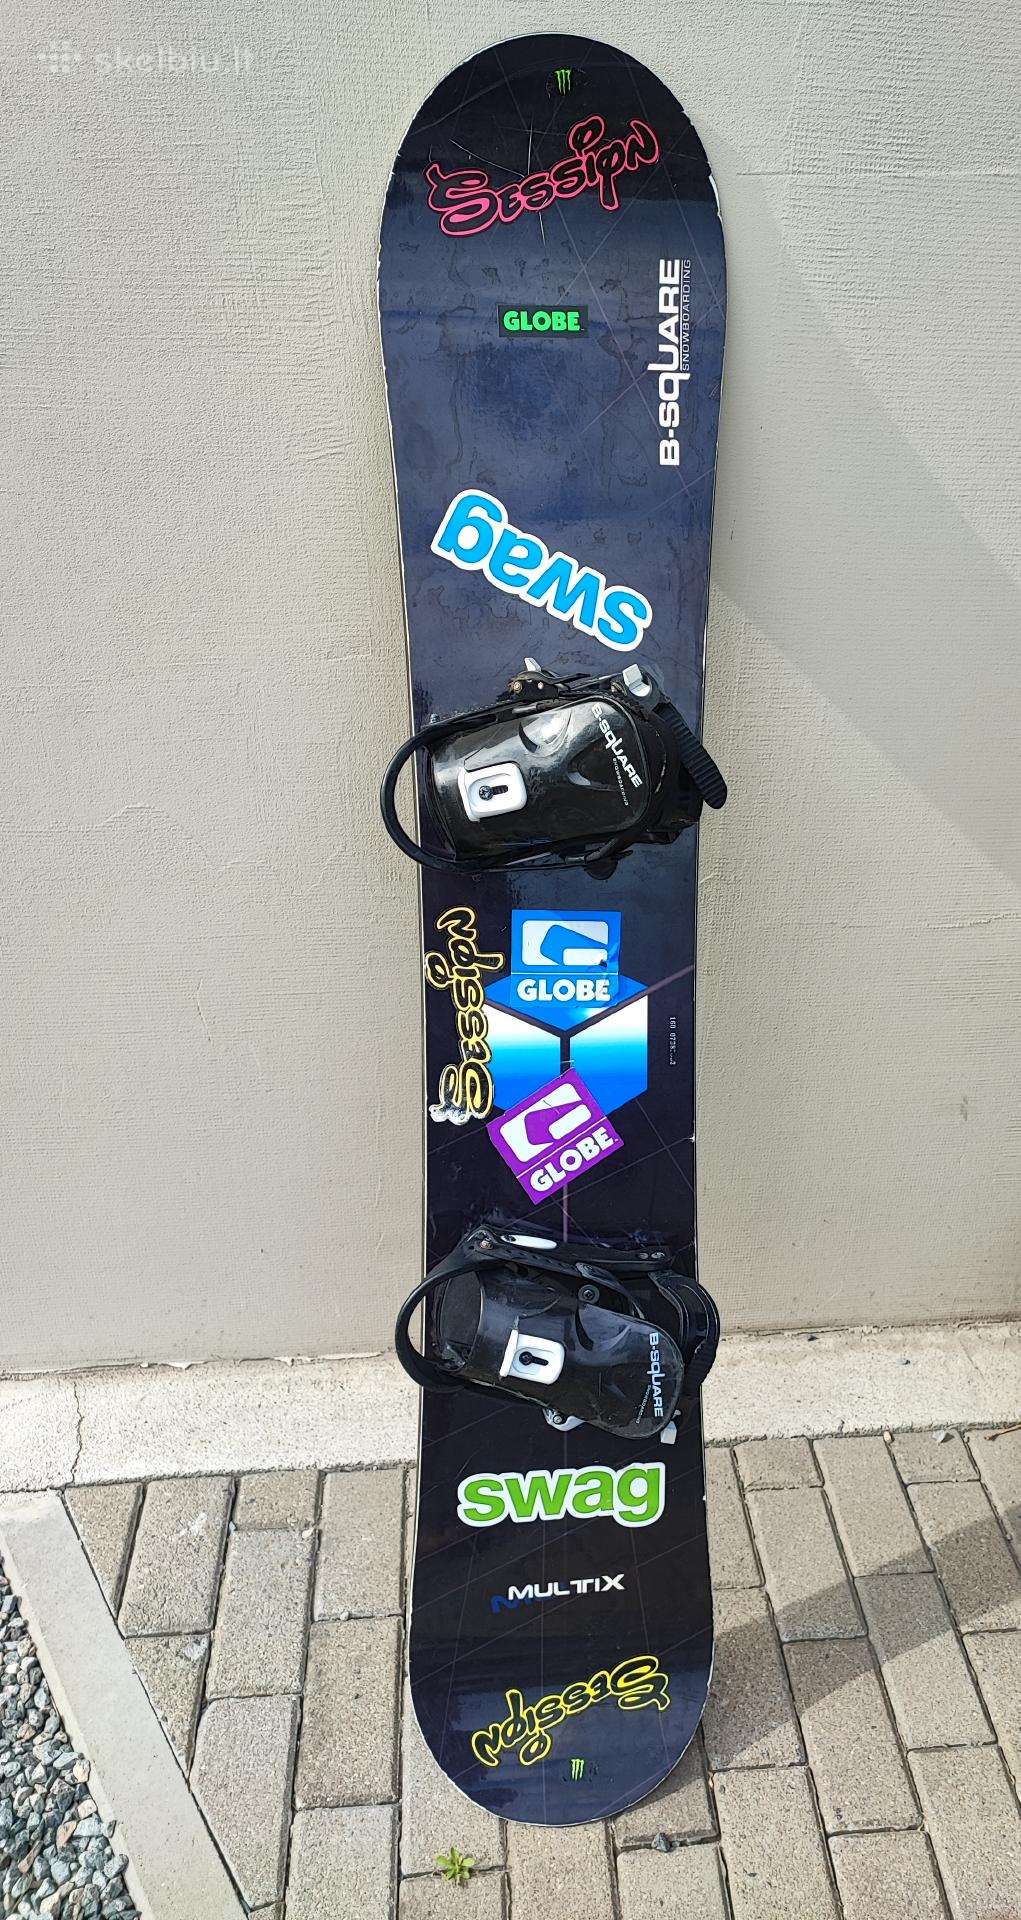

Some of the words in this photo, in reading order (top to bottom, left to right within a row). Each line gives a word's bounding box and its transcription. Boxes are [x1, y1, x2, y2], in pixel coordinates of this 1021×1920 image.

[503, 310, 580, 331] GLOBE
[682, 259, 692, 371] SNOWBOARDING
[434, 491, 650, 648] swag
[517, 979, 611, 1002] GLOBE
[530, 1125, 617, 1193] GLOBE
[461, 1463, 662, 1525] swag
[508, 1574, 625, 1600] MULTIX
